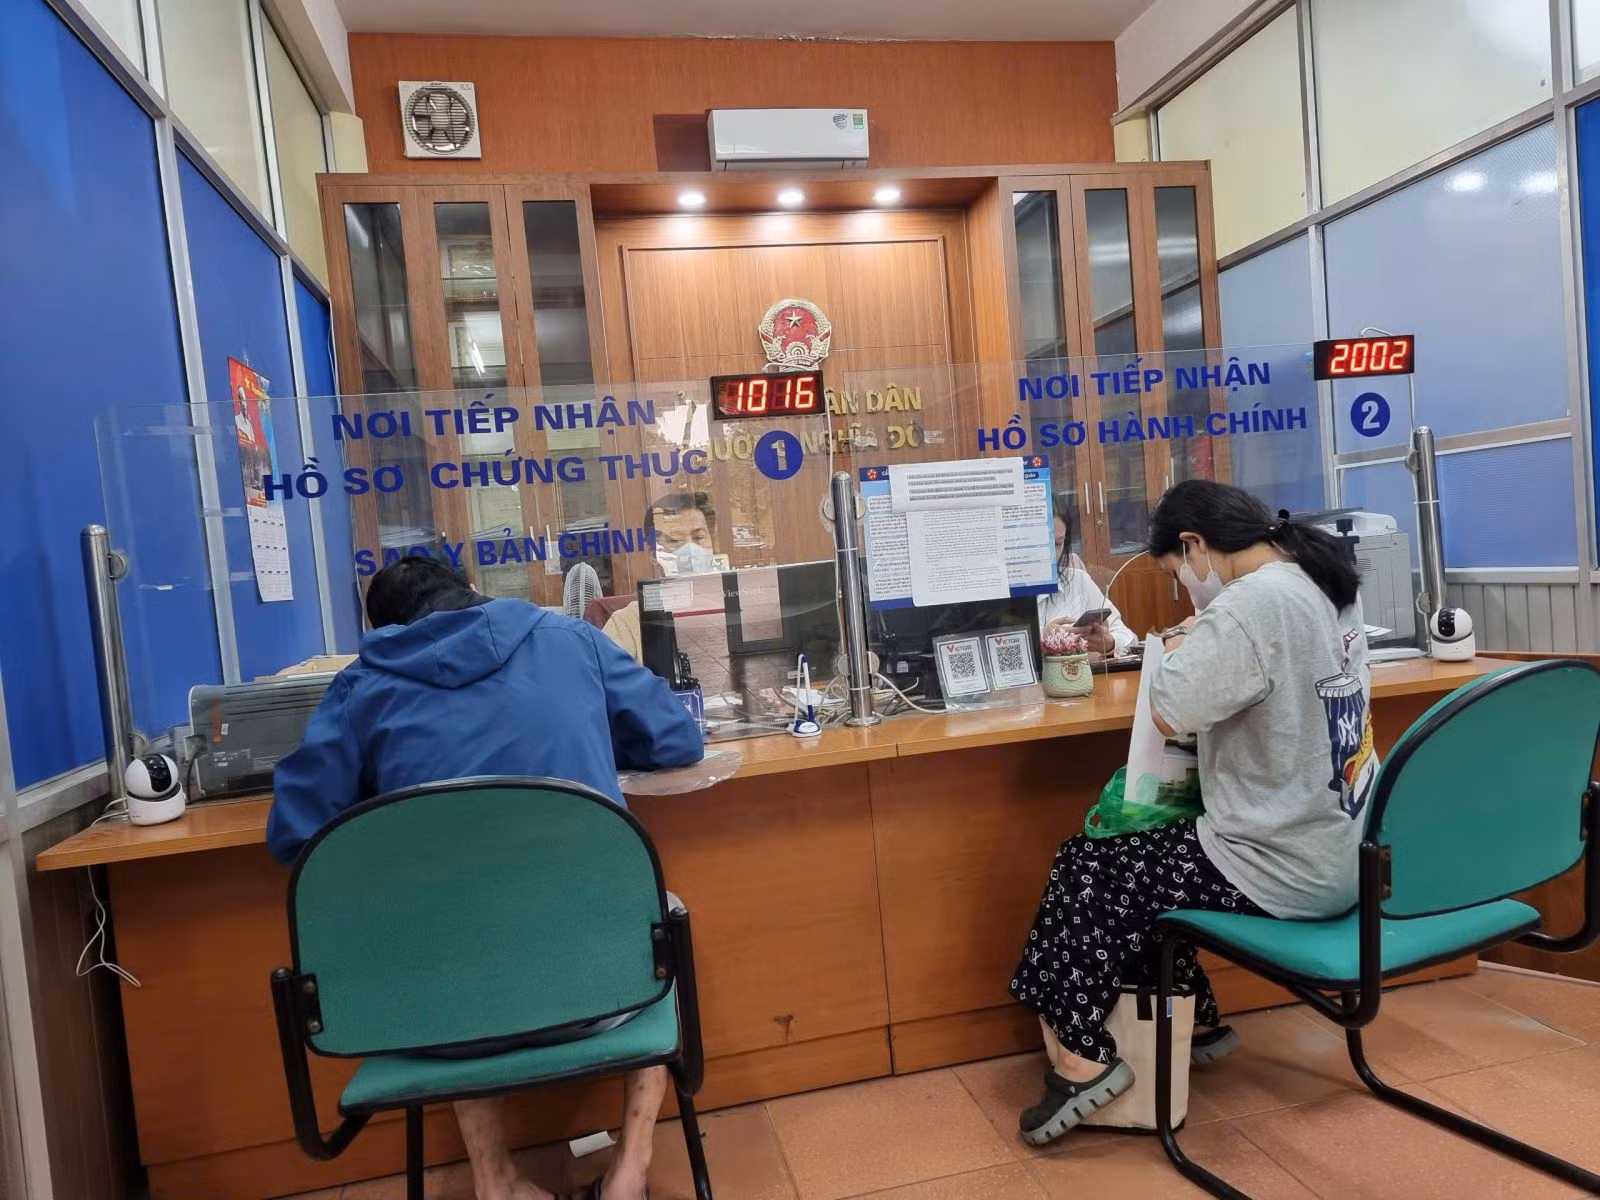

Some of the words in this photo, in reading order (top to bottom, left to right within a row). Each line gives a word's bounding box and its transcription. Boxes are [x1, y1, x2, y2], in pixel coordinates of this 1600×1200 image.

[1020, 374, 1080, 401] NƠI
[1090, 358, 1163, 396] TIẾP
[1174, 358, 1271, 393] NHẬN
[1330, 341, 1408, 374] 2002
[332, 409, 410, 441] NƠI
[426, 394, 519, 435] TIẾP
[535, 395, 656, 435] NHẬN
[865, 383, 922, 413] DÂN
[1362, 400, 1381, 430] 2
[978, 414, 1027, 451] HỒ
[1039, 421, 1086, 448] SƠ
[1099, 410, 1195, 444] HÀNH
[1206, 402, 1308, 437] CHÍNH
[264, 457, 328, 501] HỒ
[344, 463, 406, 496] SƠ
[431, 448, 585, 489] CHỨNG
[600, 447, 708, 484] THỰC
[443, 542, 465, 569] Y
[477, 527, 547, 567] BẢN
[558, 522, 658, 560] CHÍNH
